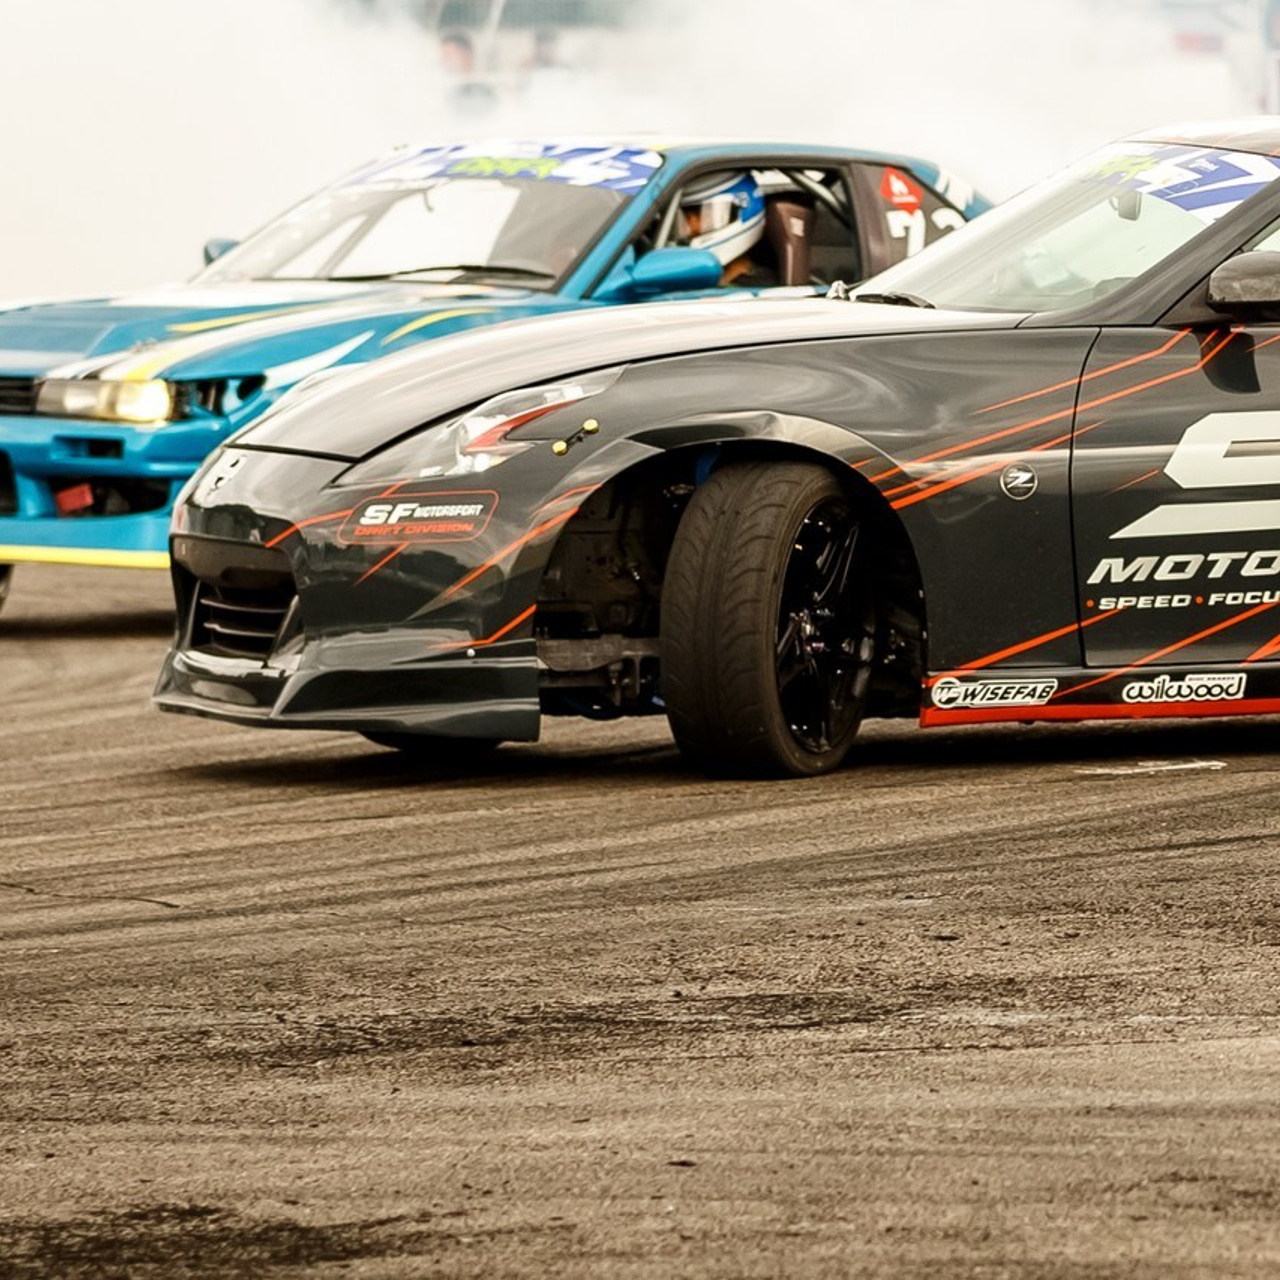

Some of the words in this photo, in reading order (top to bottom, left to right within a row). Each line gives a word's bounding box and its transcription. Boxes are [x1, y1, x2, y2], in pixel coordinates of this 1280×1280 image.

[886, 208, 968, 258] 7
[359, 503, 420, 525] SF
[413, 505, 484, 518] MOTORSPORT
[354, 526, 400, 536] DRIFT
[404, 523, 475, 535] DIVISION
[1098, 594, 1192, 610] SPEED
[962, 683, 1056, 703] WISEFAB
[1126, 676, 1244, 700] wilwood
